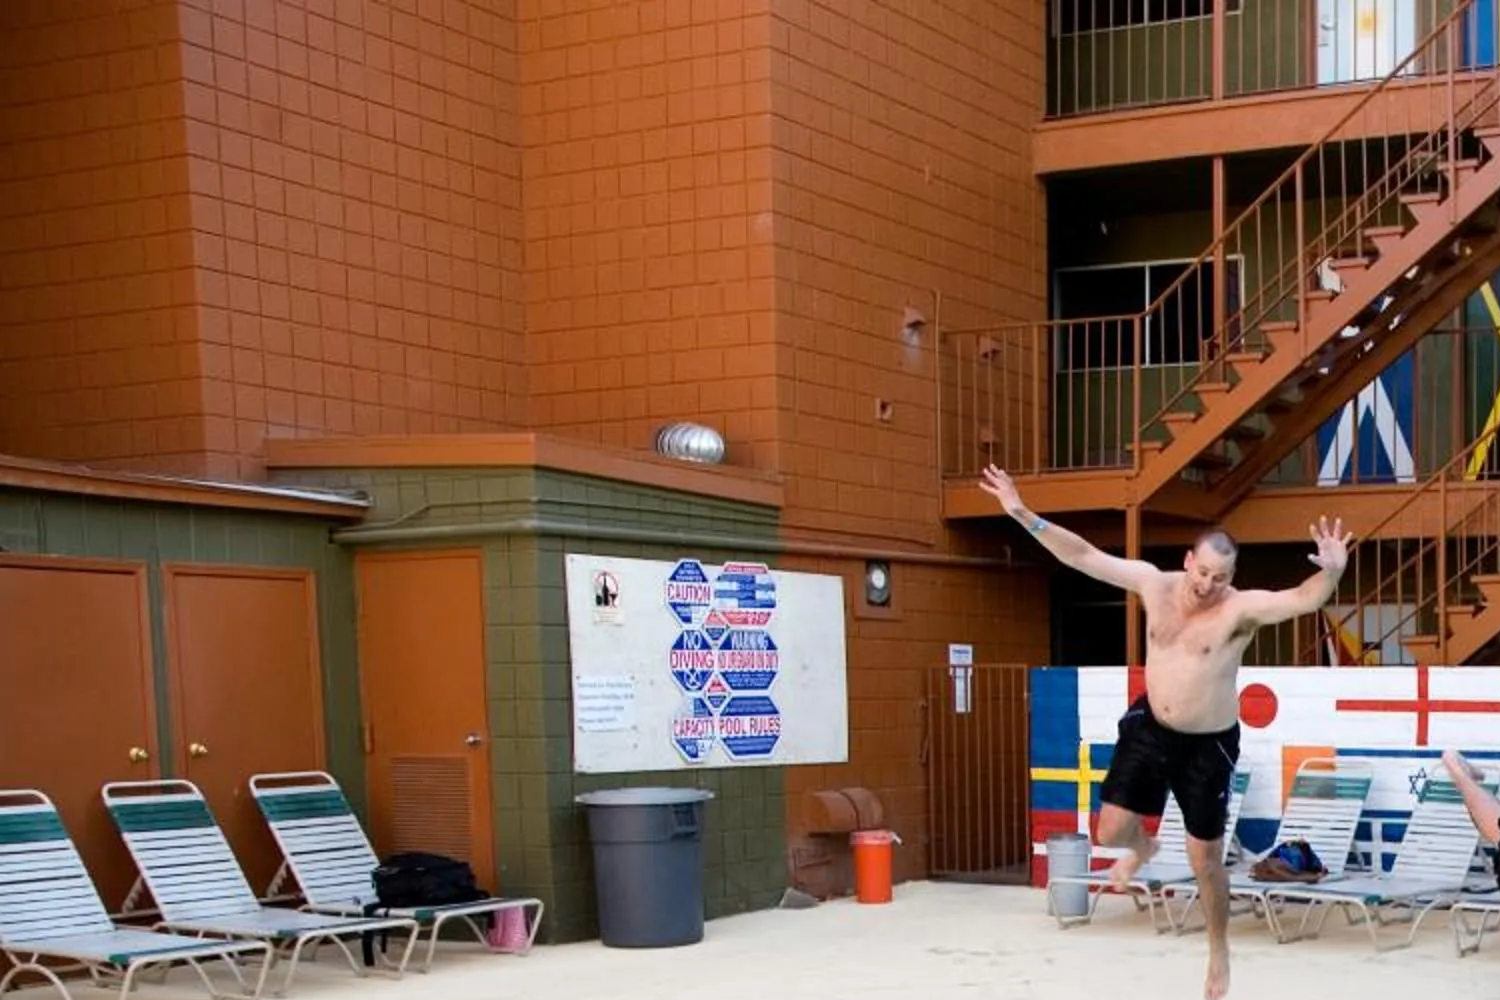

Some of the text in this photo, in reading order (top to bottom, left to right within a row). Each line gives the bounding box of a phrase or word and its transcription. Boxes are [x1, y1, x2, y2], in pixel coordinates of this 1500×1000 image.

[667, 584, 711, 601] CAUTION
[683, 630, 702, 649] NO
[670, 650, 714, 669] DIVING
[673, 718, 715, 737] CAPACITY
[720, 716, 781, 735] POOL RULES
